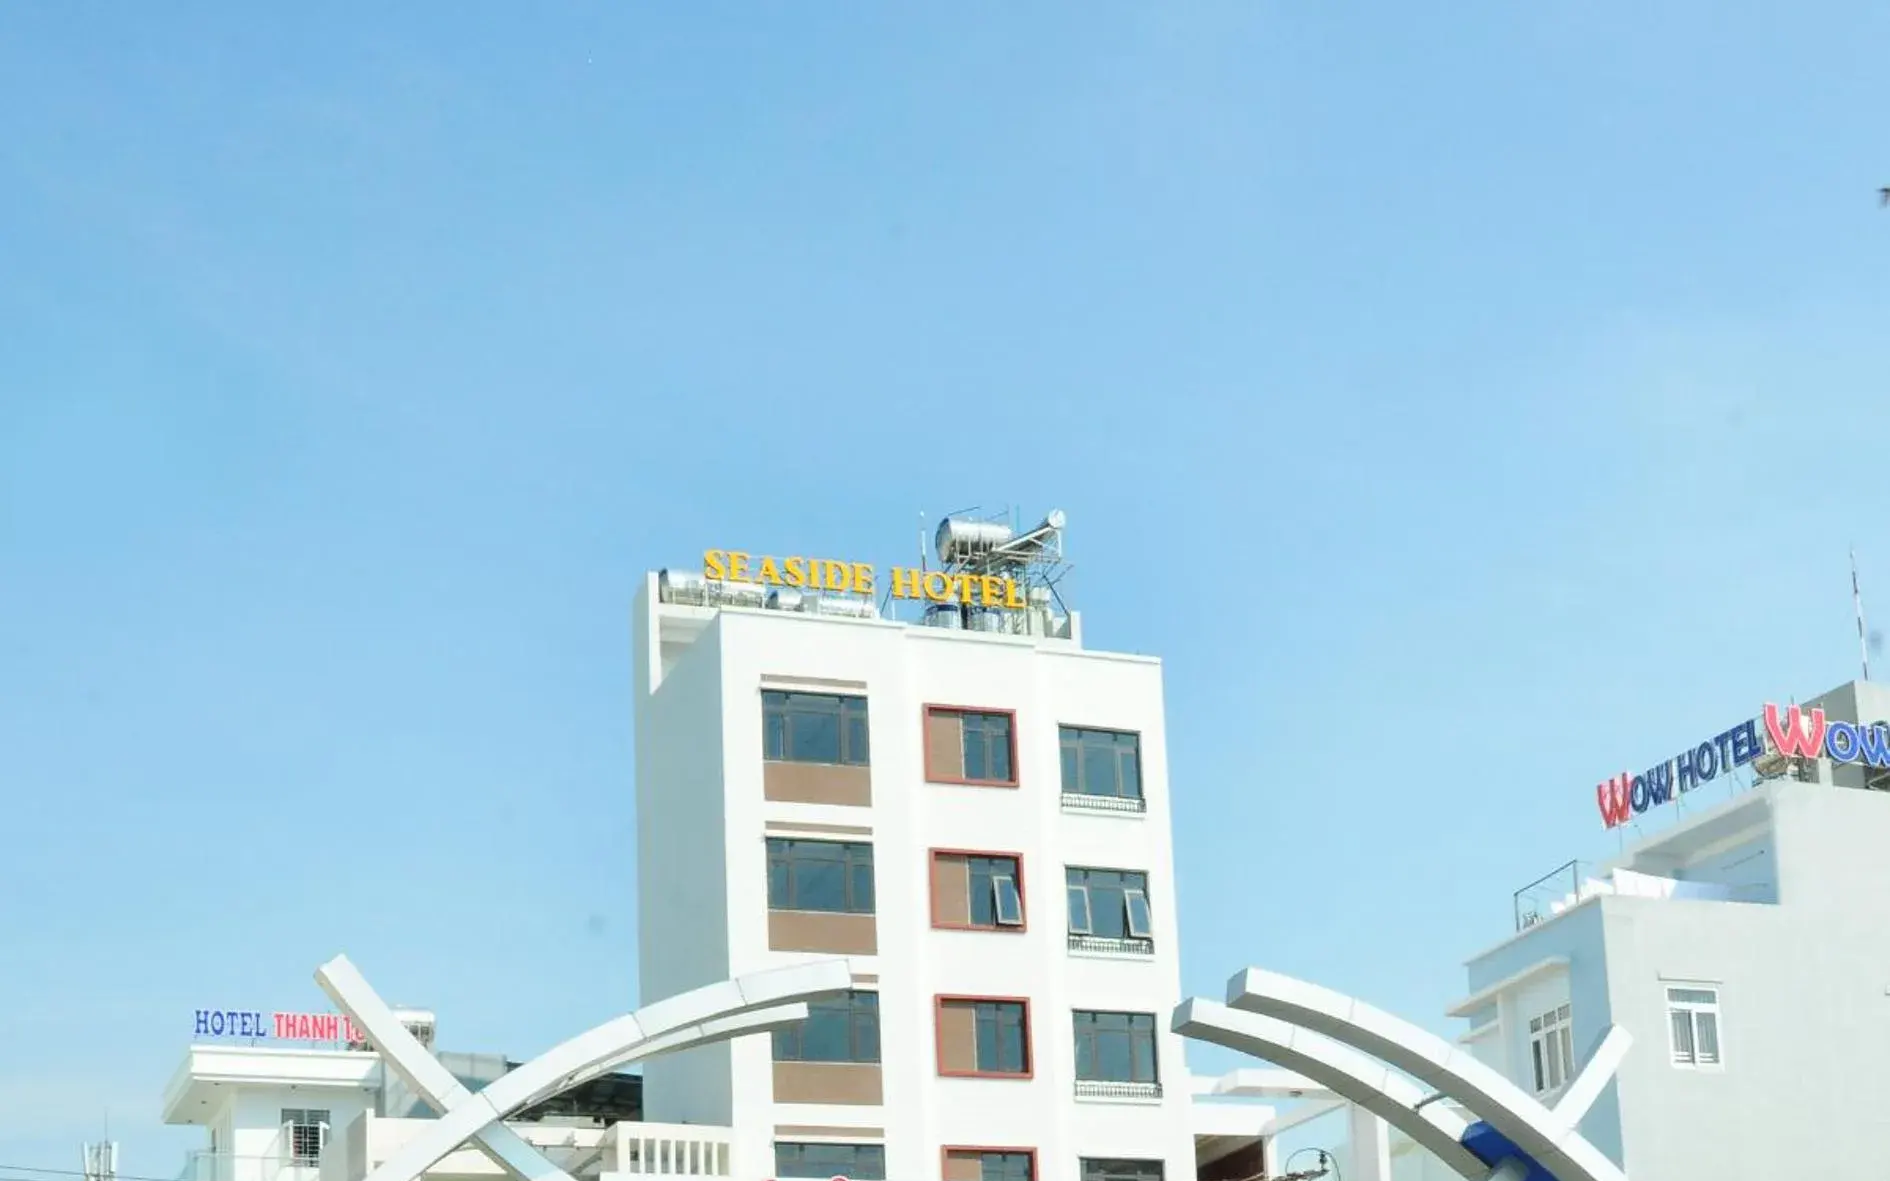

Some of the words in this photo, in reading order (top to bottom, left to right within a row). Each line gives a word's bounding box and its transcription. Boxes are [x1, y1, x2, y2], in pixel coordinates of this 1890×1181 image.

[703, 549, 874, 594] SEASIDE
[889, 565, 1028, 608] HOTEL
[1678, 719, 1762, 793] HOTEL
[194, 1010, 266, 1037] HOTEL
[273, 1013, 339, 1041] THANH
